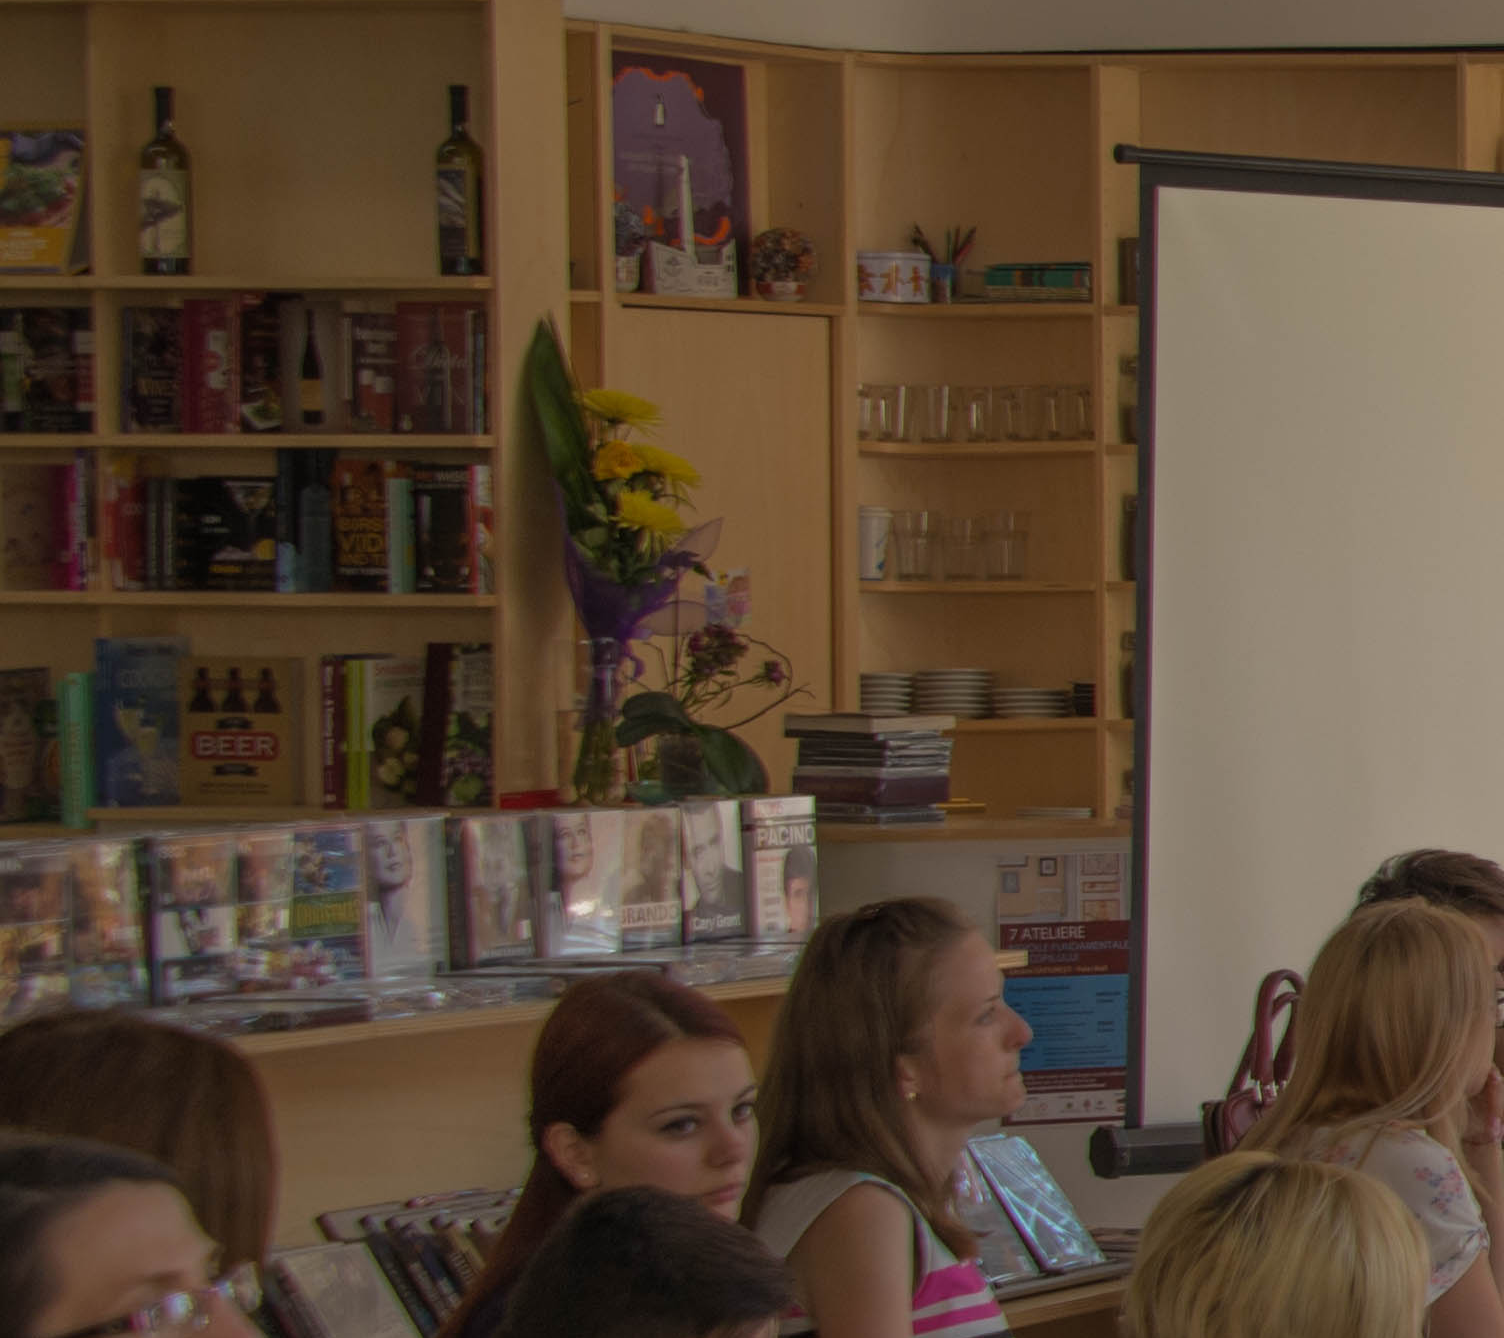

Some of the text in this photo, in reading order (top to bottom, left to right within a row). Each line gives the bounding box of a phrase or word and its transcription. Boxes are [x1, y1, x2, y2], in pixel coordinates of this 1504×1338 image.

[197, 735, 275, 757] BEER
[756, 825, 816, 846] PACINO
[1008, 926, 1086, 941] 7 ATELIERE
